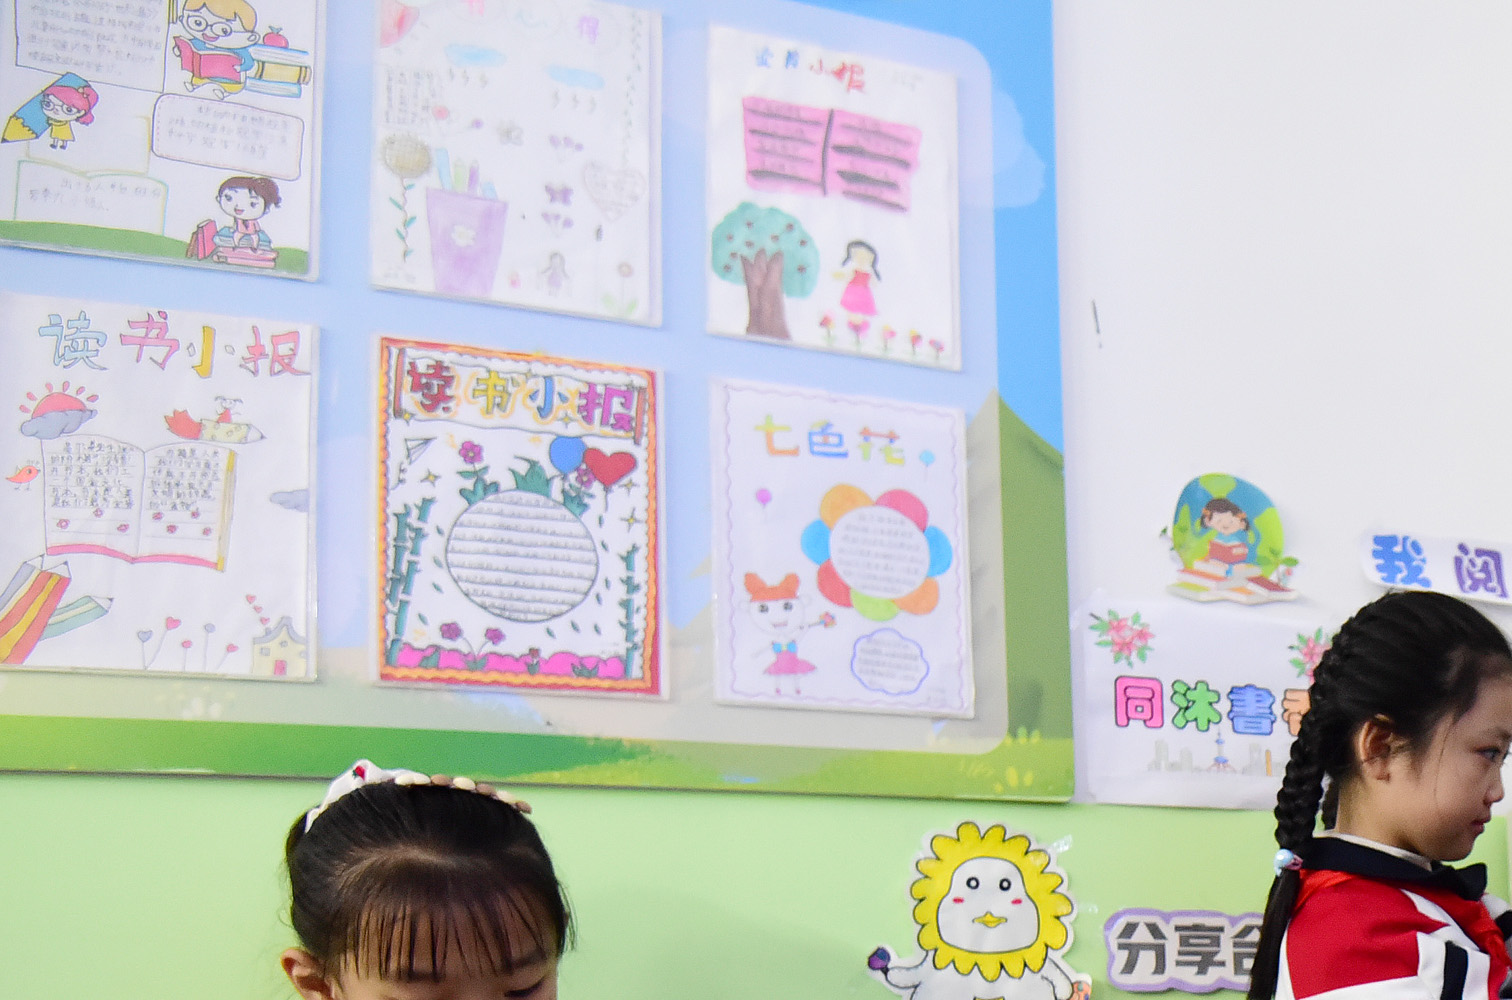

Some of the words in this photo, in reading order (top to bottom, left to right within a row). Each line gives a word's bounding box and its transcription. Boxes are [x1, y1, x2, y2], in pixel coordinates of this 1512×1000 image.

[38, 310, 312, 378] 读书小报
[408, 361, 633, 432] 读书小报
[754, 414, 906, 465] 七色花
